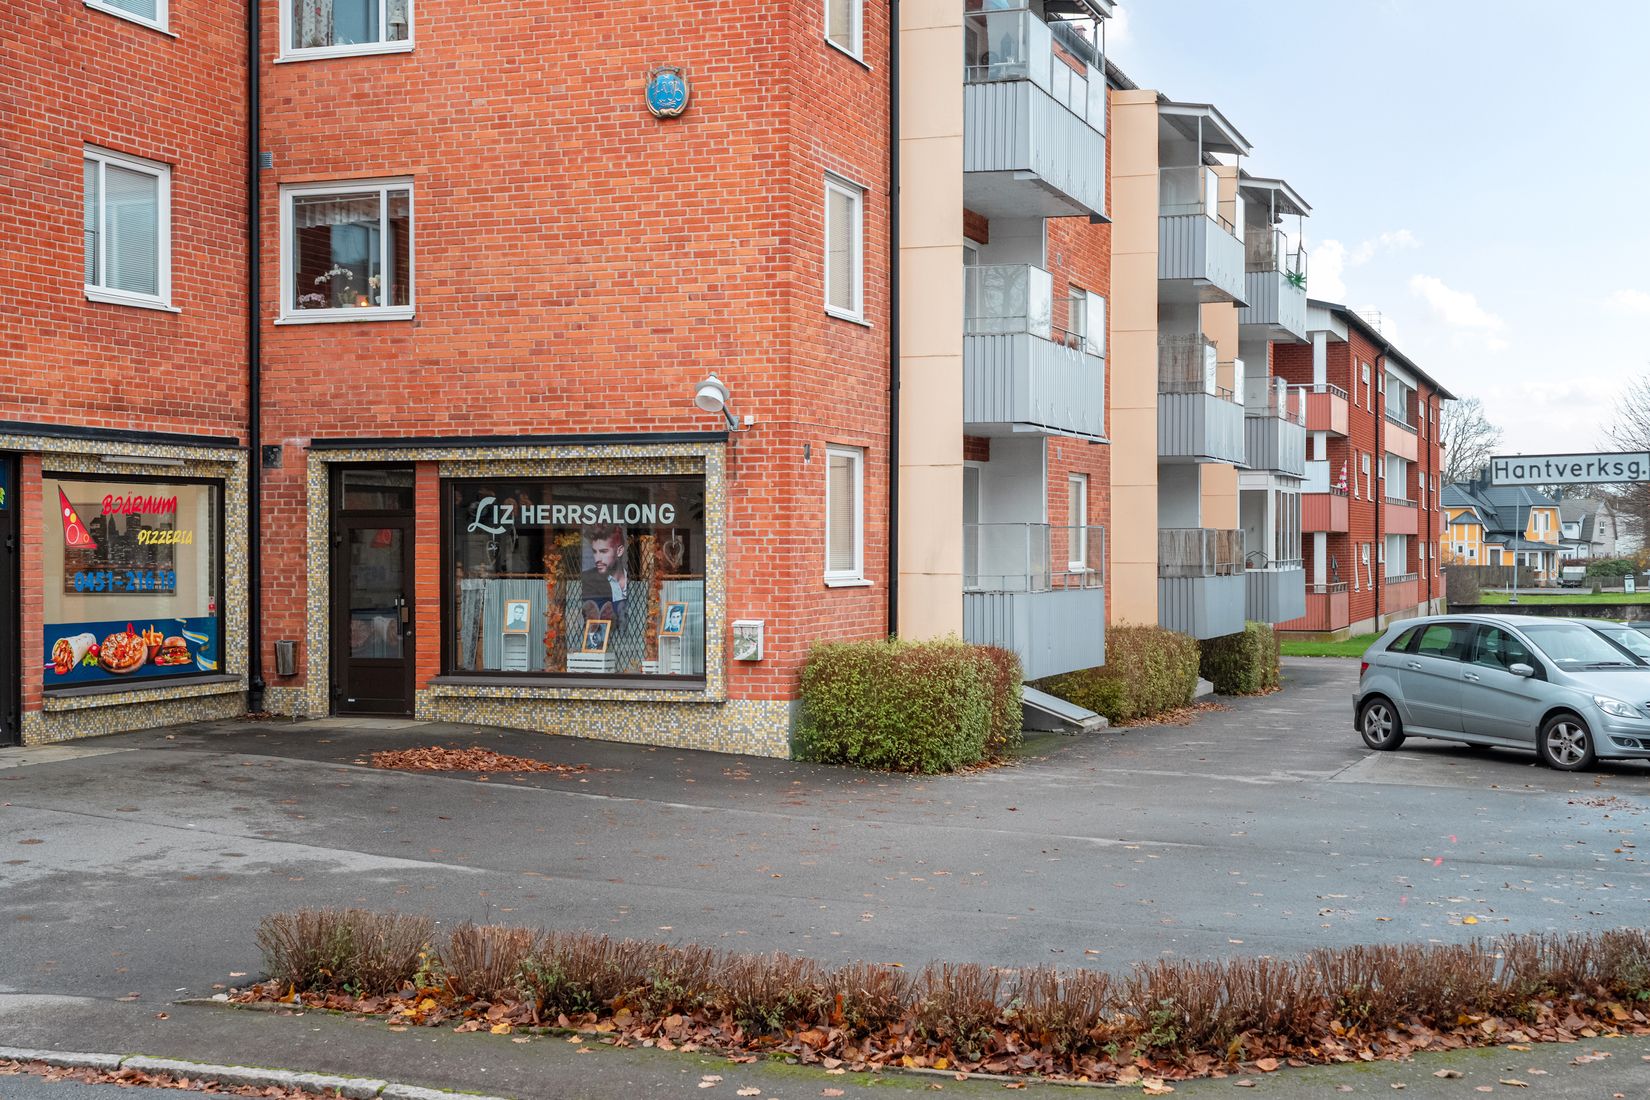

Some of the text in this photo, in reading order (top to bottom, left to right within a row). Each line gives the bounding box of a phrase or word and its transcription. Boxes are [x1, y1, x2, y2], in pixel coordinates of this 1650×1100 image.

[1494, 458, 1647, 480] Hantverksg.
[101, 491, 177, 515] BJÄRNUM
[467, 496, 675, 535] LIZ HERRSALONG
[137, 529, 193, 545] PIZZERIA
